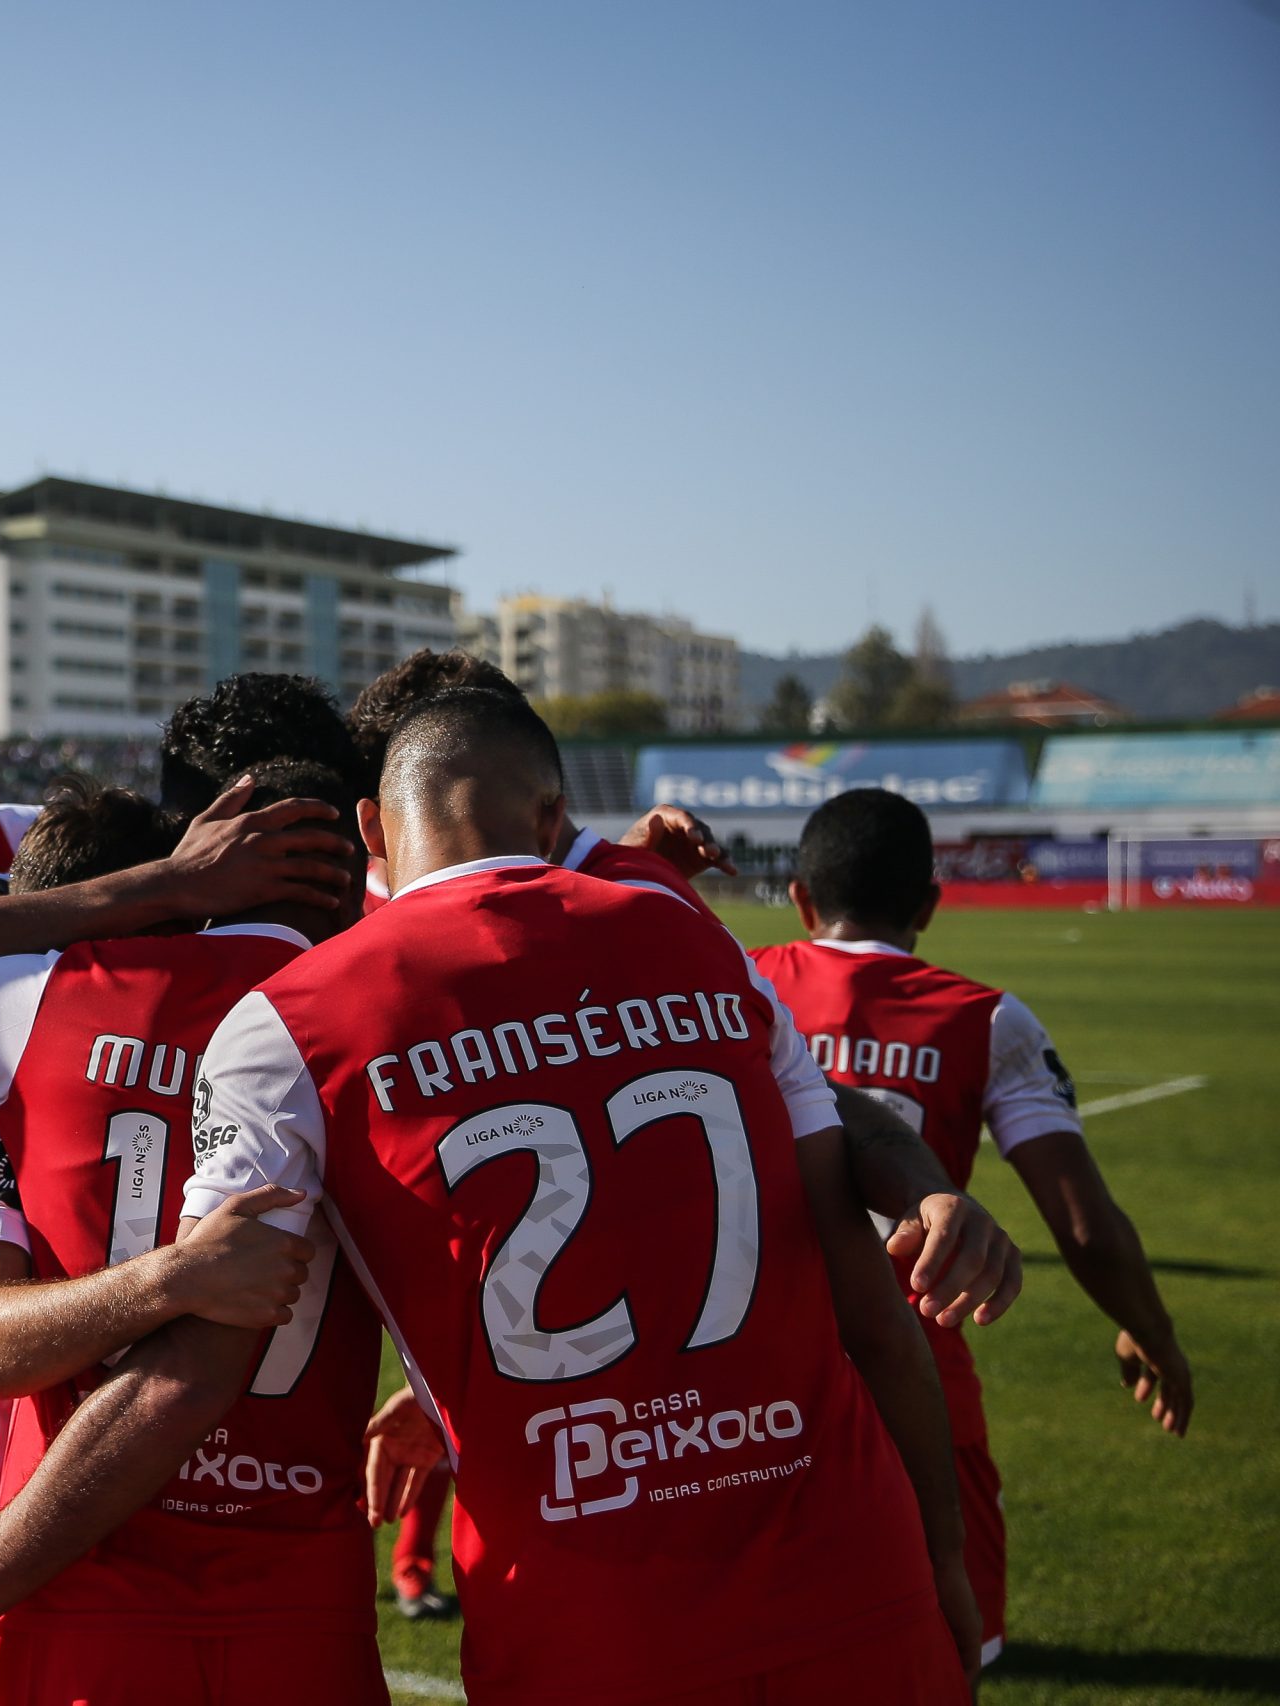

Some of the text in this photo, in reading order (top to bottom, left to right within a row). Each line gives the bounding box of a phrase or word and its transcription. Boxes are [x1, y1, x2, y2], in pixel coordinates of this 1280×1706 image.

[366, 988, 750, 1113] FRANSÉRGIO
[632, 1089, 667, 1107] LIGA
[465, 1127, 501, 1147] LIGA
[131, 1167, 146, 1199] LIGA
[436, 1070, 760, 1382] 27
[633, 1389, 702, 1420] CASA
[538, 1398, 804, 1510] Peixoto
[648, 1454, 813, 1503] IDEIAS CONSTRUTIVAS
